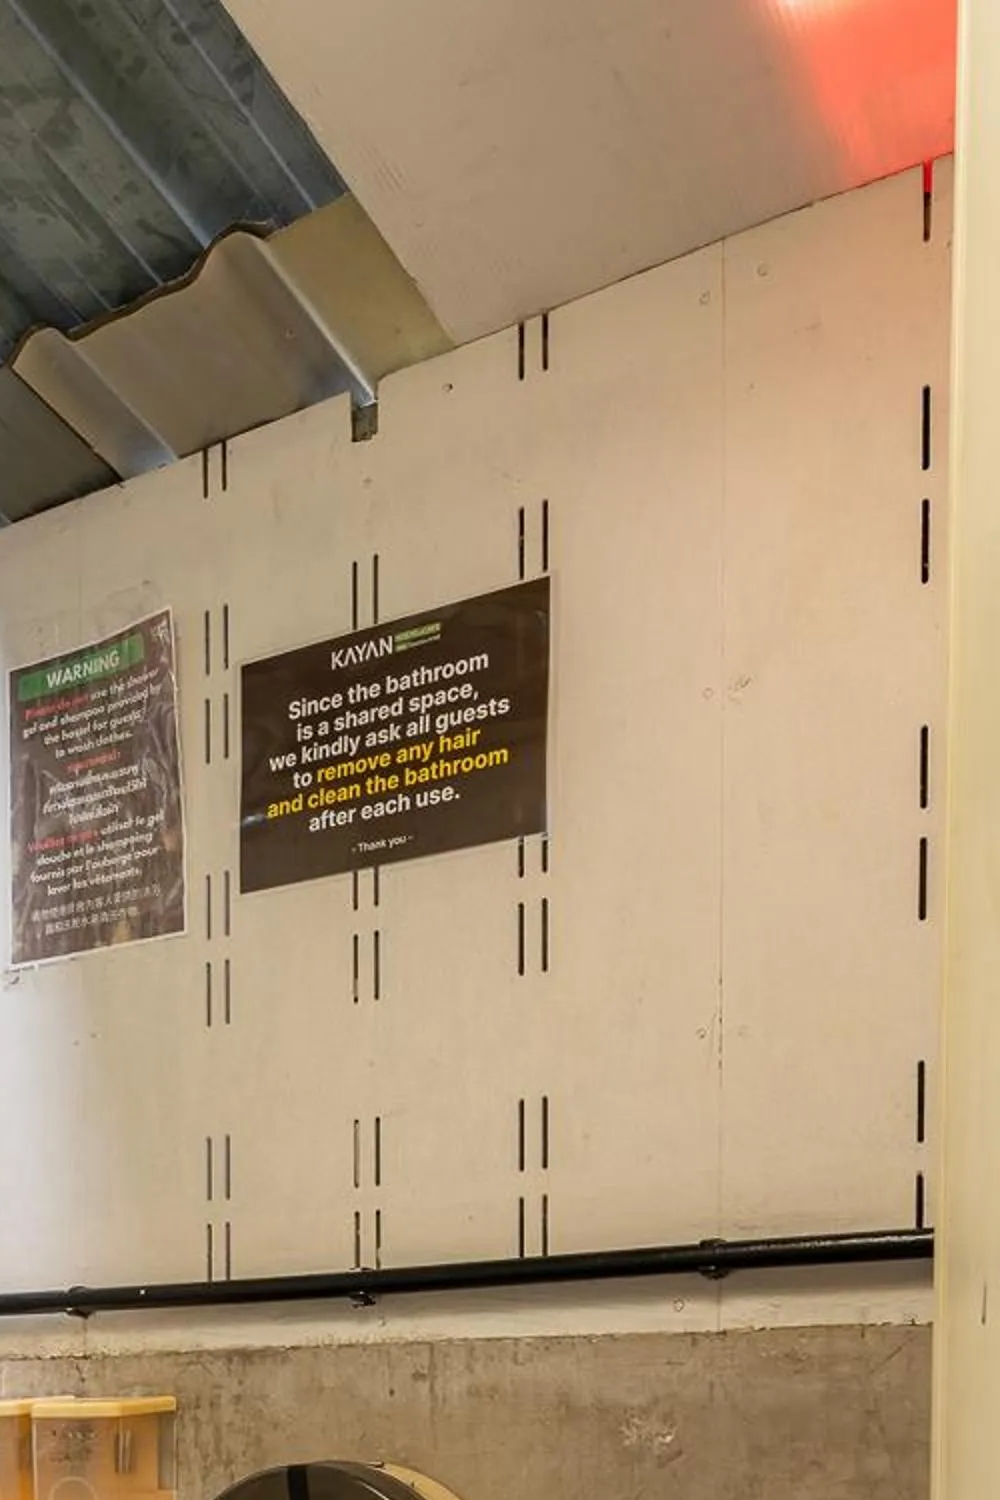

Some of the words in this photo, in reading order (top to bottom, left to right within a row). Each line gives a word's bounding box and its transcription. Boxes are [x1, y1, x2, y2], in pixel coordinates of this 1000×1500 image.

[46, 649, 120, 689] WARNING
[331, 635, 393, 670] KAYAN
[288, 692, 343, 720] Since
[347, 680, 381, 705] the
[385, 652, 489, 694] bathroom
[297, 722, 313, 742] is
[317, 720, 329, 736] a
[334, 697, 403, 733] shared
[408, 682, 479, 715] space,
[269, 753, 297, 772] we
[301, 734, 360, 765] kindly
[365, 723, 400, 748] ask
[406, 715, 430, 739] all
[435, 696, 510, 734] guests
[293, 770, 313, 789] to
[316, 752, 392, 782] remove
[396, 743, 433, 765] any
[439, 726, 482, 754] hair
[266, 793, 303, 818] and
[307, 783, 361, 810] clean
[365, 772, 399, 796] the
[404, 747, 509, 787] bathroom
[308, 807, 357, 832] after
[361, 793, 411, 820] each
[415, 784, 460, 807] use.
[357, 840, 386, 852] Thank
[388, 835, 406, 848] you
